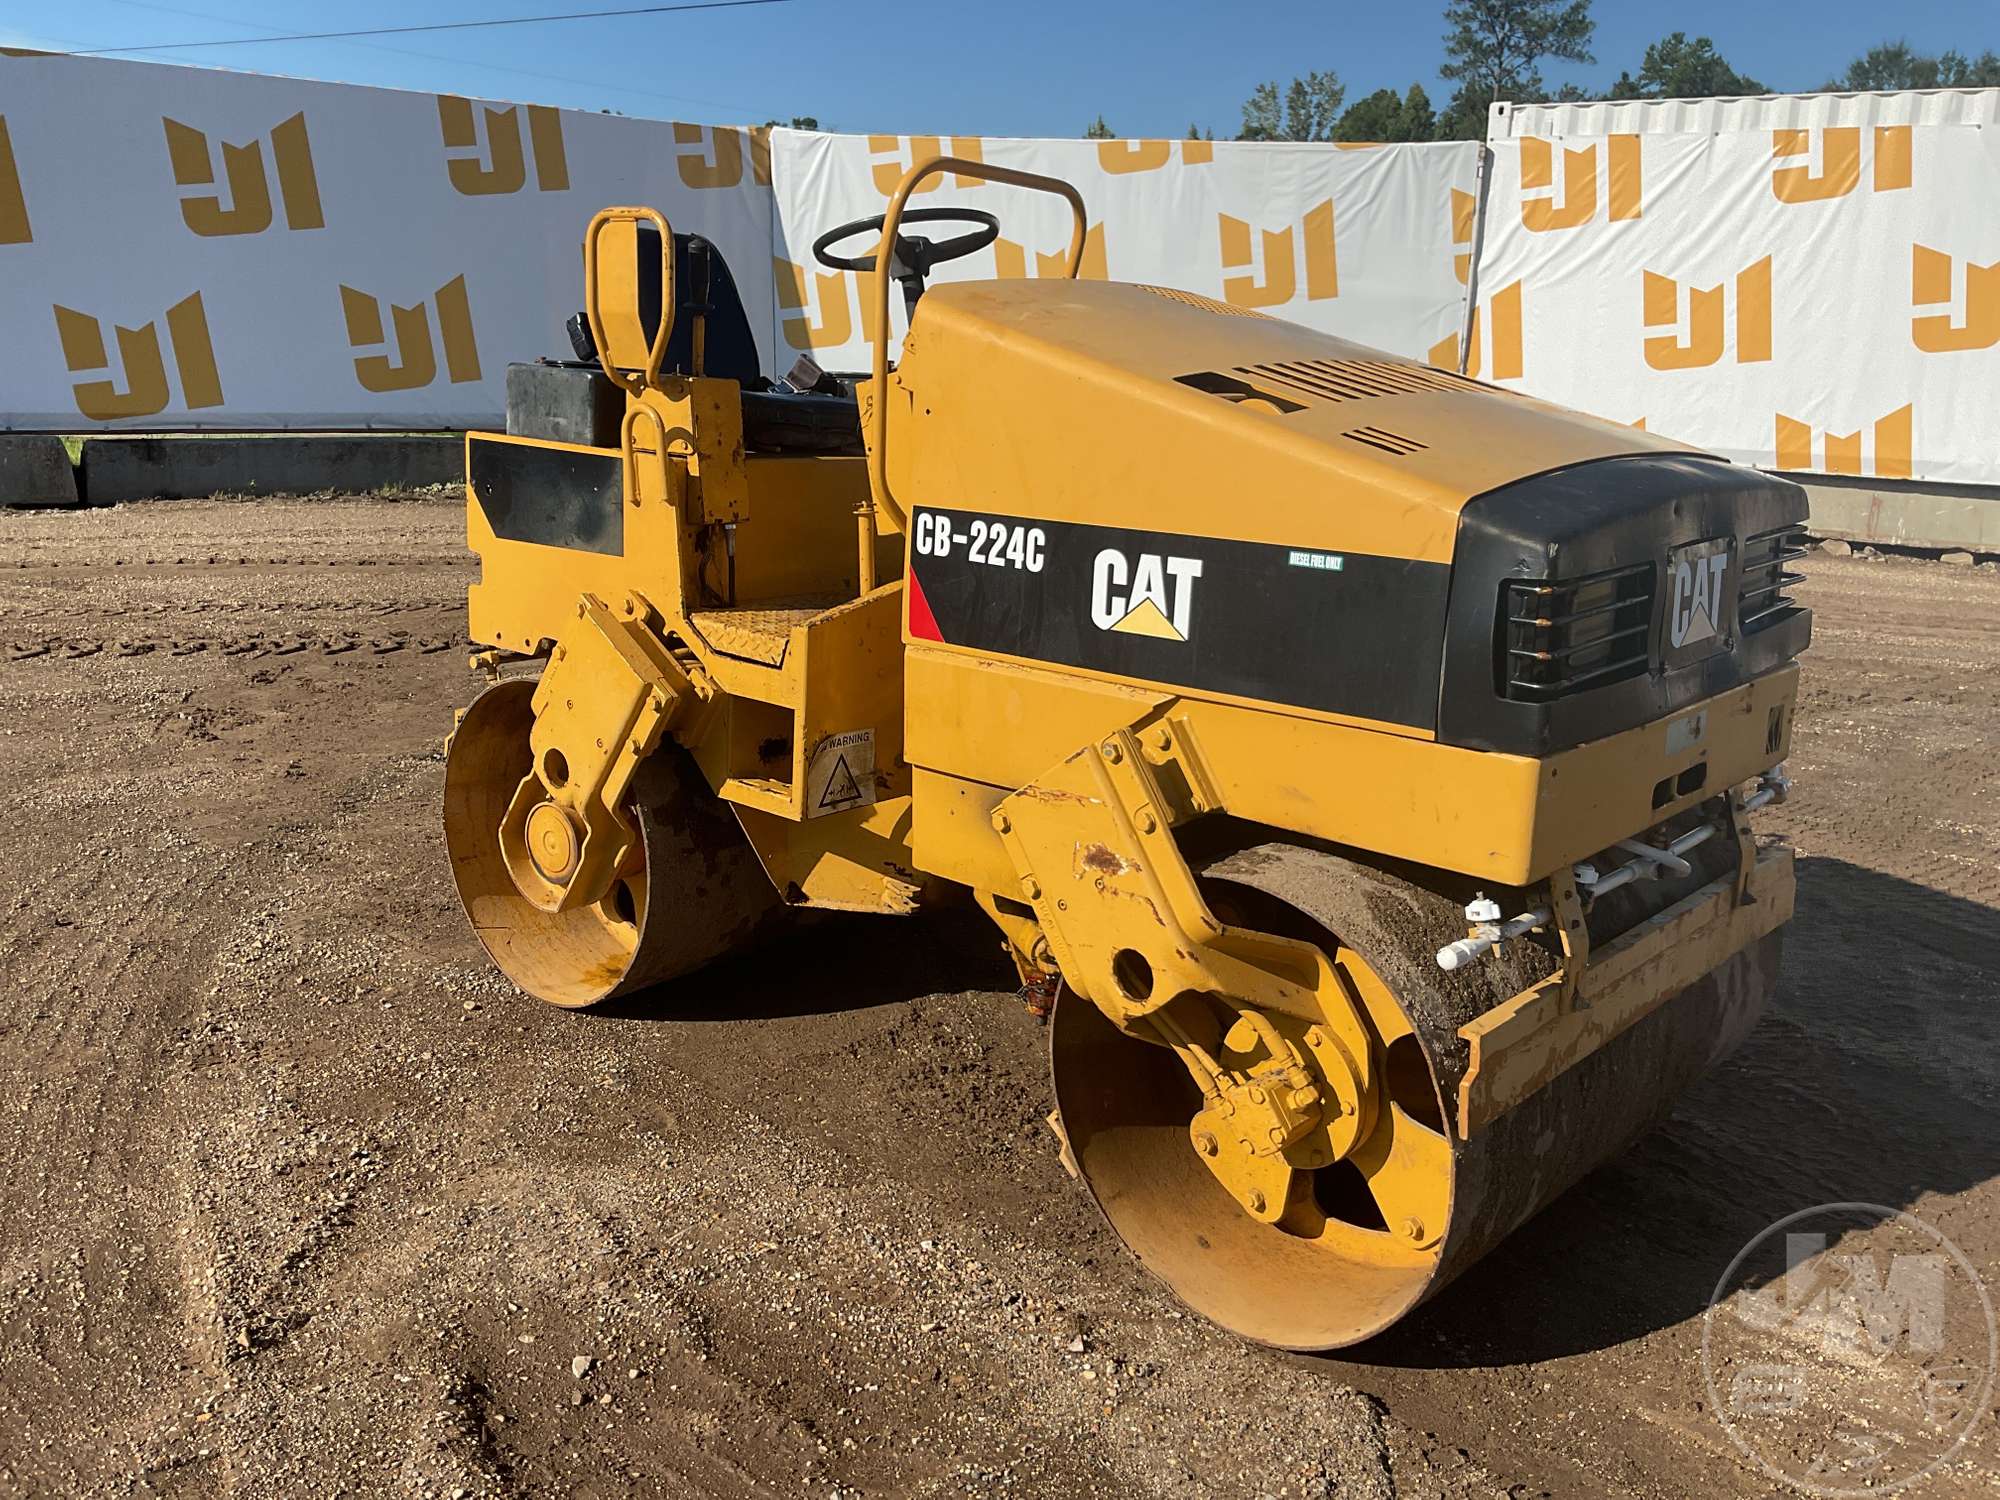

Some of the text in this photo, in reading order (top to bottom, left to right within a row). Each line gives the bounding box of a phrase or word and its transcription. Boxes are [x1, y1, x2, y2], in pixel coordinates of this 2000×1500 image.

[916, 513, 1046, 573] CB-224C
[1091, 548, 1203, 641] CAT
[1671, 553, 1728, 648] CAT
[829, 732, 870, 749] WARNING
